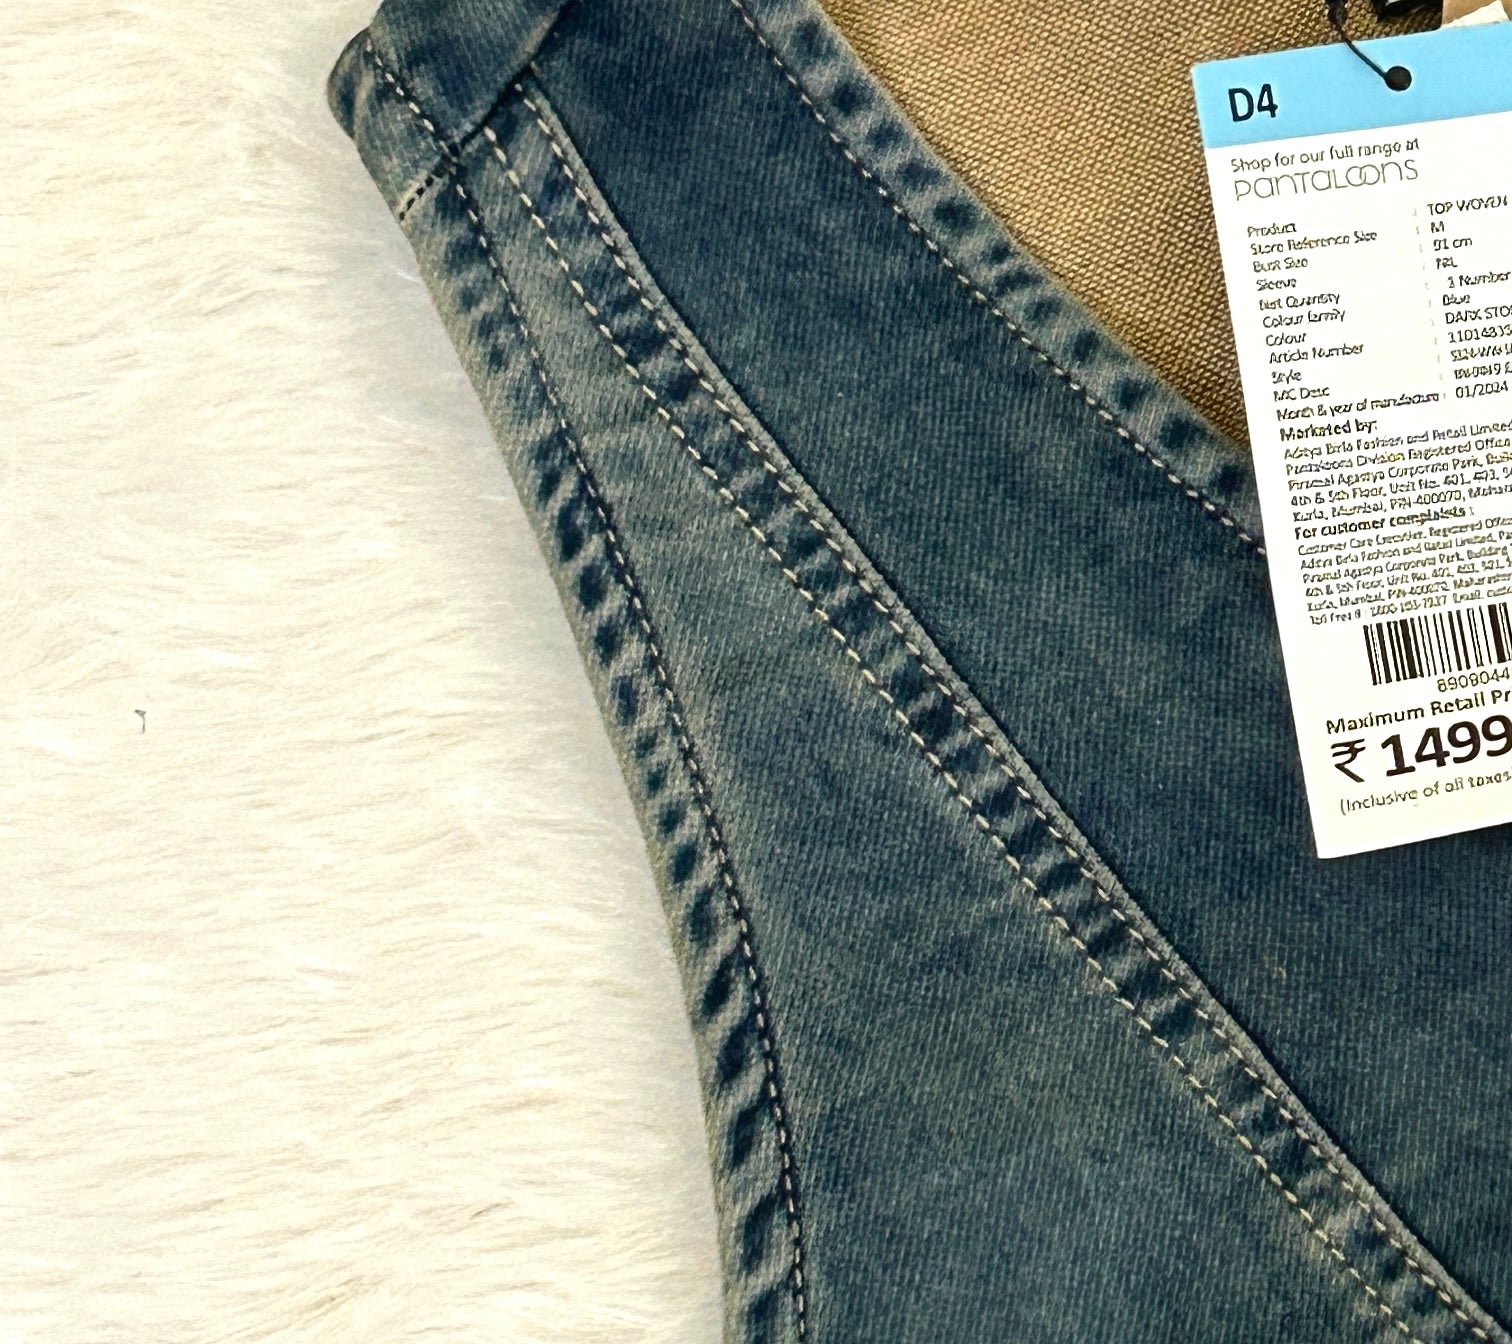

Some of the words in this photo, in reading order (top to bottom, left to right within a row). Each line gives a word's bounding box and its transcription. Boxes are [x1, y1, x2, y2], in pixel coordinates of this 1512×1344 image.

[1227, 83, 1279, 123] D4
[1231, 158, 1272, 173] Shop
[1274, 152, 1295, 167] for
[1300, 150, 1324, 164] our
[1329, 144, 1354, 160] full
[1358, 141, 1402, 158] range
[1427, 201, 1454, 216] TOP
[1455, 380, 1509, 399] 01/2024
[1326, 707, 1425, 735] Maximum
[1430, 691, 1486, 716] Retail
[1330, 738, 1366, 783] ₹
[1340, 789, 1418, 816] (Inclusive
[1423, 781, 1439, 798] of
[1445, 777, 1464, 793] all
